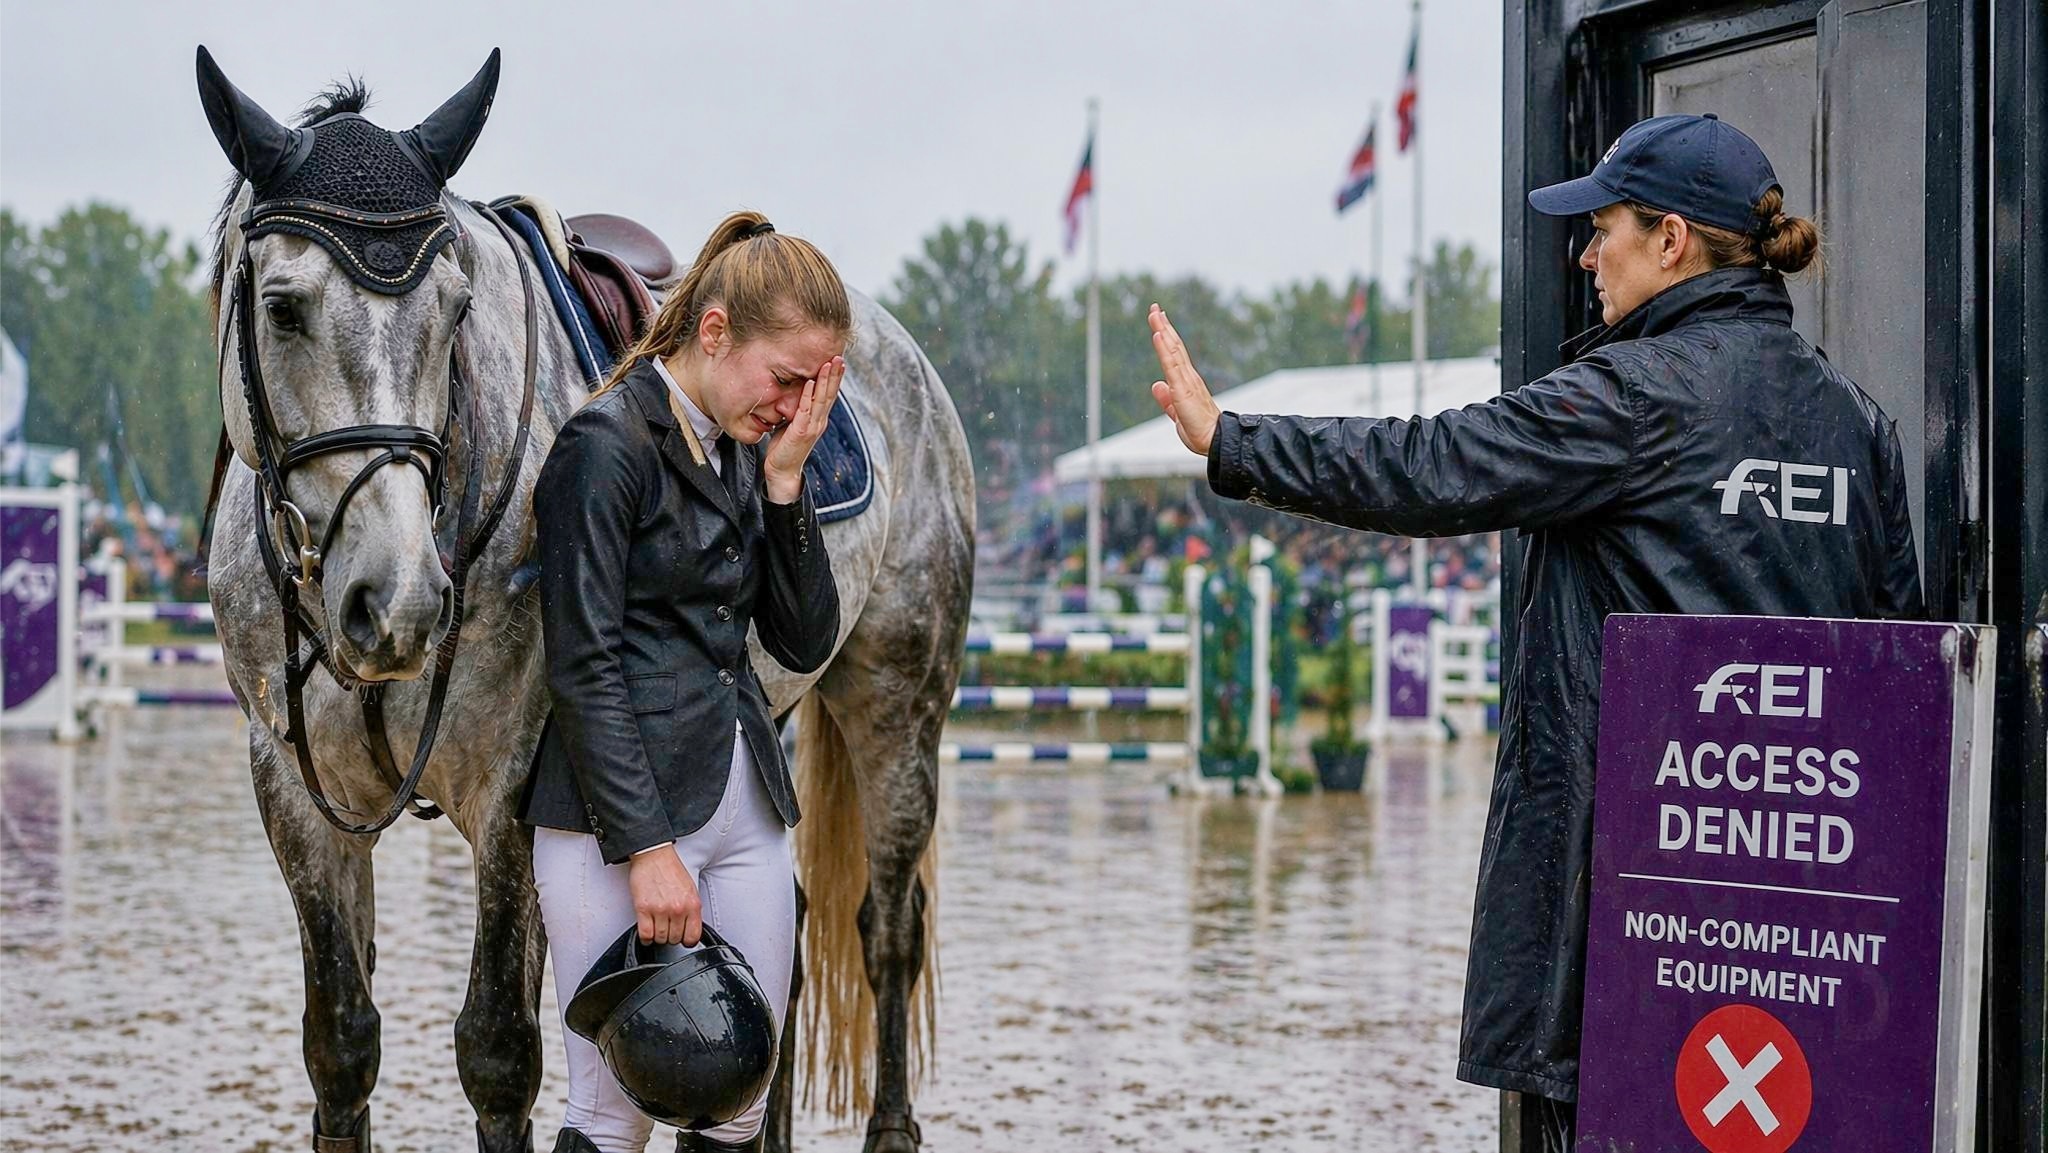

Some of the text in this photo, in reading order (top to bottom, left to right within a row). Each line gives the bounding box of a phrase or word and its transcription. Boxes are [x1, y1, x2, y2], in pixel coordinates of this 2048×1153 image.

[1712, 458, 1849, 526] FEI
[1693, 663, 1825, 718] FEI
[1654, 740, 1860, 798] ACCESS
[1658, 803, 1854, 864] DENIED
[1625, 910, 1887, 965] NON-COMPLIANT
[1656, 957, 1842, 1007] EQUIPMENT
